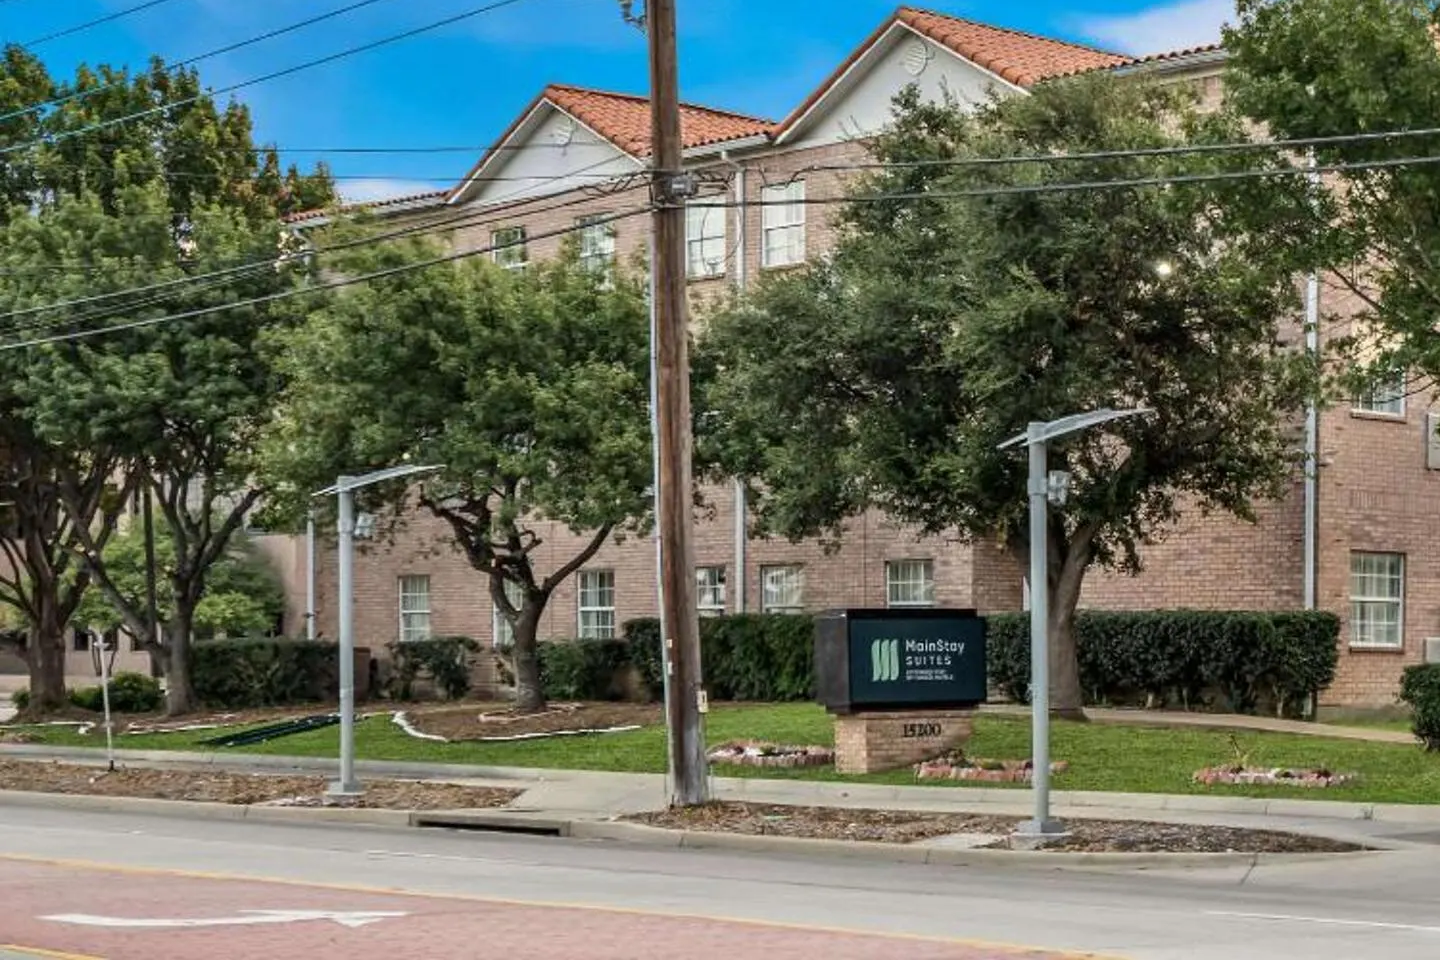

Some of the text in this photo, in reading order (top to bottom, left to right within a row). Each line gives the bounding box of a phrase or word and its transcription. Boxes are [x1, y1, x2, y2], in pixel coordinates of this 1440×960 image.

[905, 639, 965, 655] MainStay
[905, 655, 952, 666] SUITES
[903, 723, 942, 738] 15200
